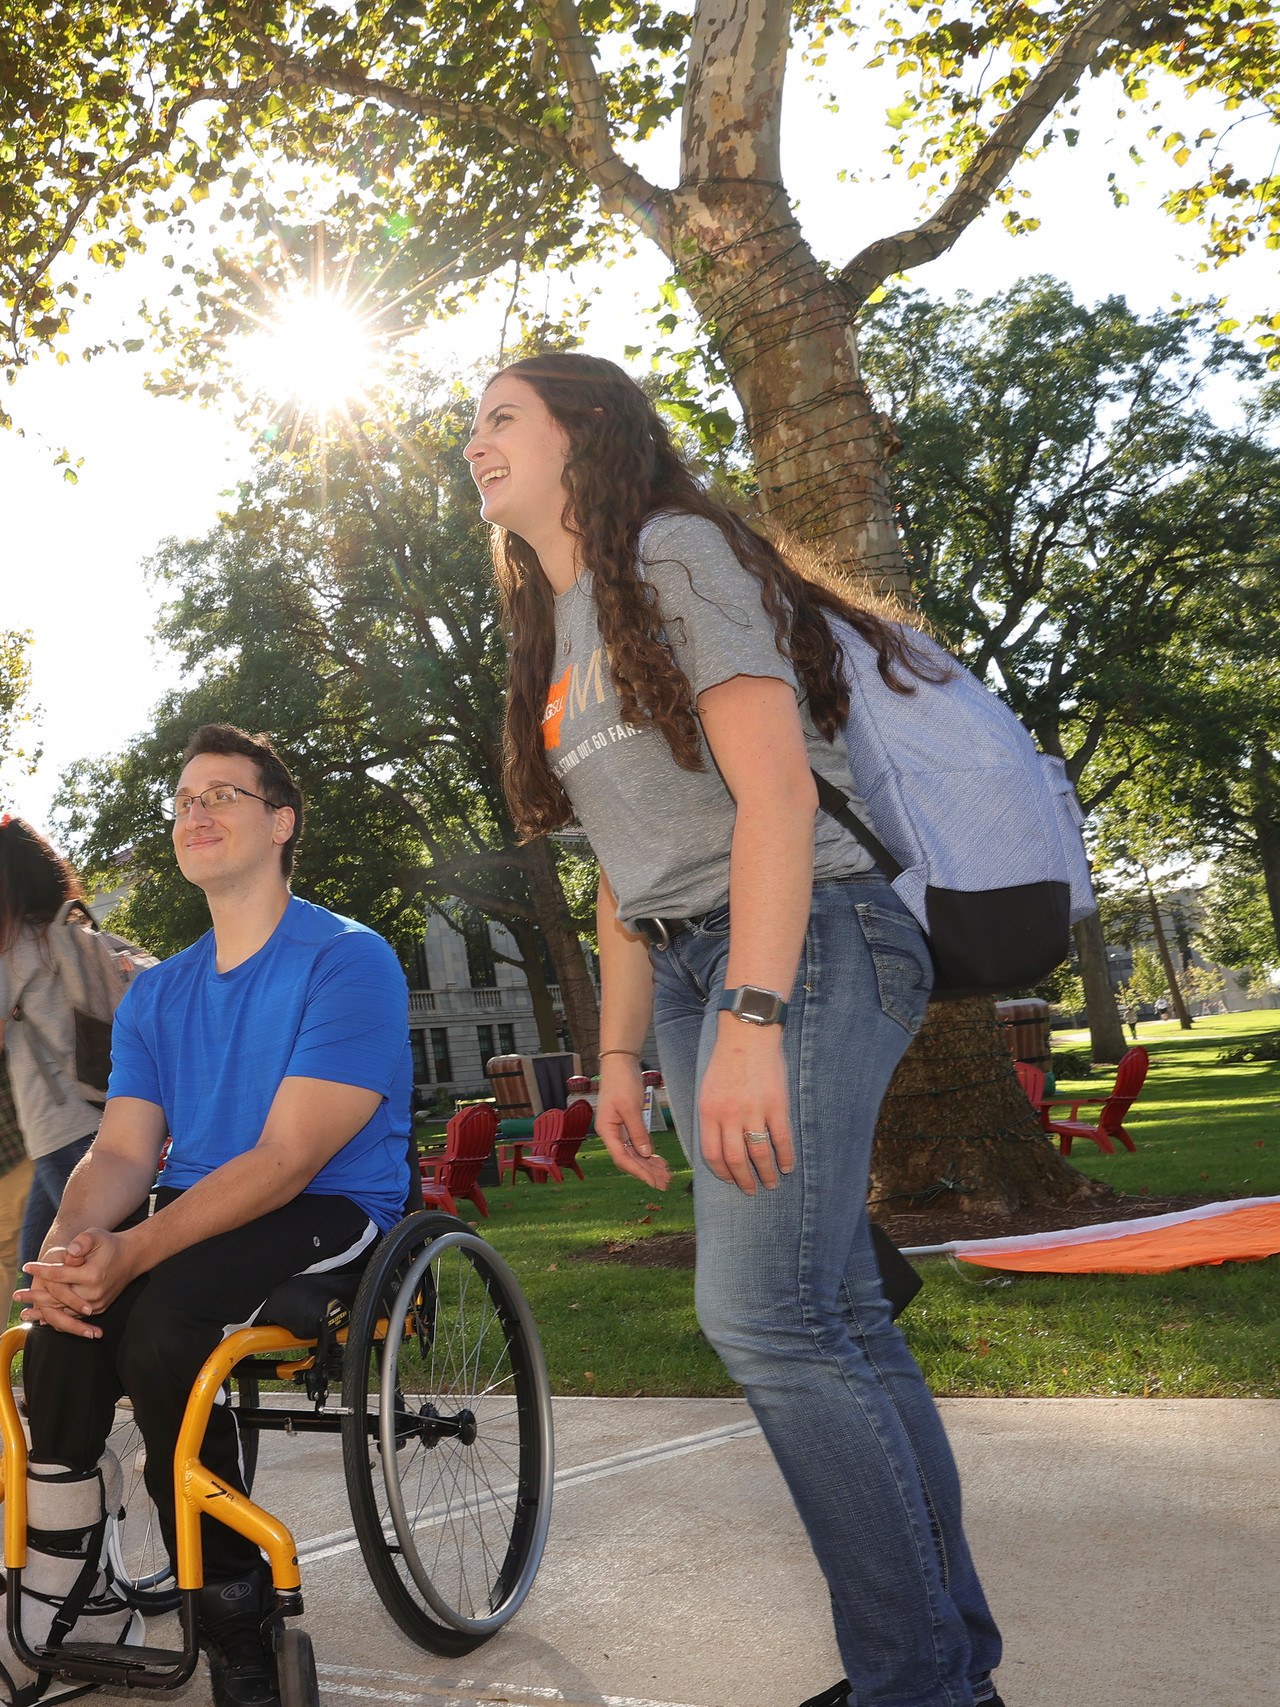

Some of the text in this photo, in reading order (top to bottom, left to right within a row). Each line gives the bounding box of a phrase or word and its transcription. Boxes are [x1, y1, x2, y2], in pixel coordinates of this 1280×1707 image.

[559, 750, 580, 773] STAND
[577, 740, 595, 759] OUT.
[592, 732, 607, 749] GO
